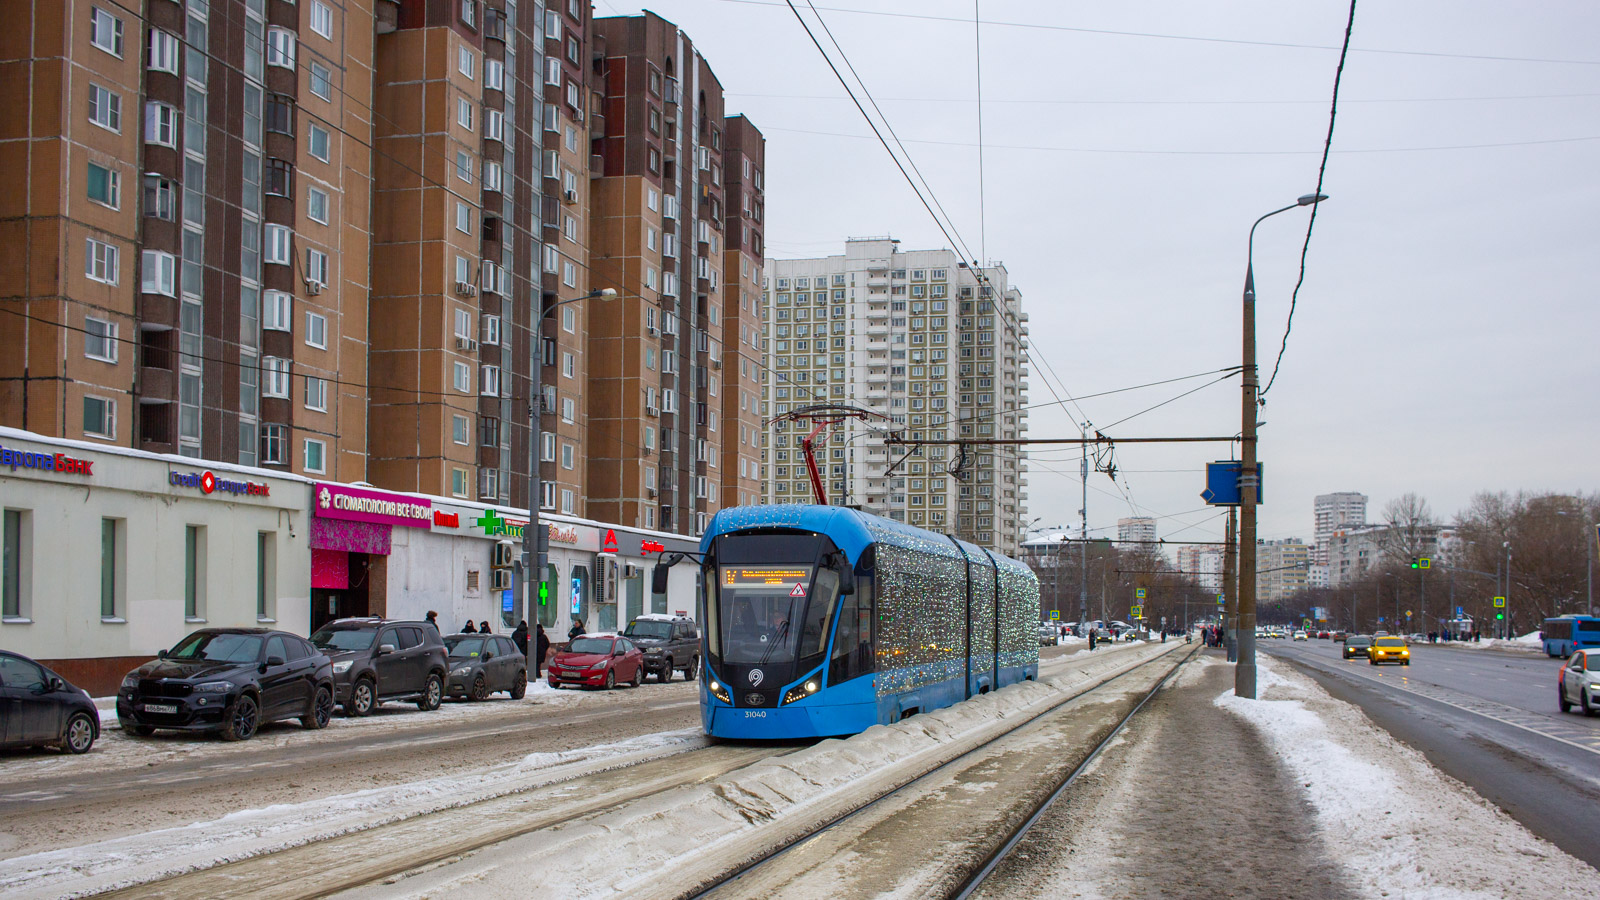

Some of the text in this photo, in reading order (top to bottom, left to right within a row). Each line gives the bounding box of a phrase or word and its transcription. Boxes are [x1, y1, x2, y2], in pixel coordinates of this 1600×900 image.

[0, 449, 94, 475] вропаБанк
[171, 471, 200, 488] Credit
[333, 494, 432, 520] СТОМАТОЛОГИЯ ВСЕ СВОИ!
